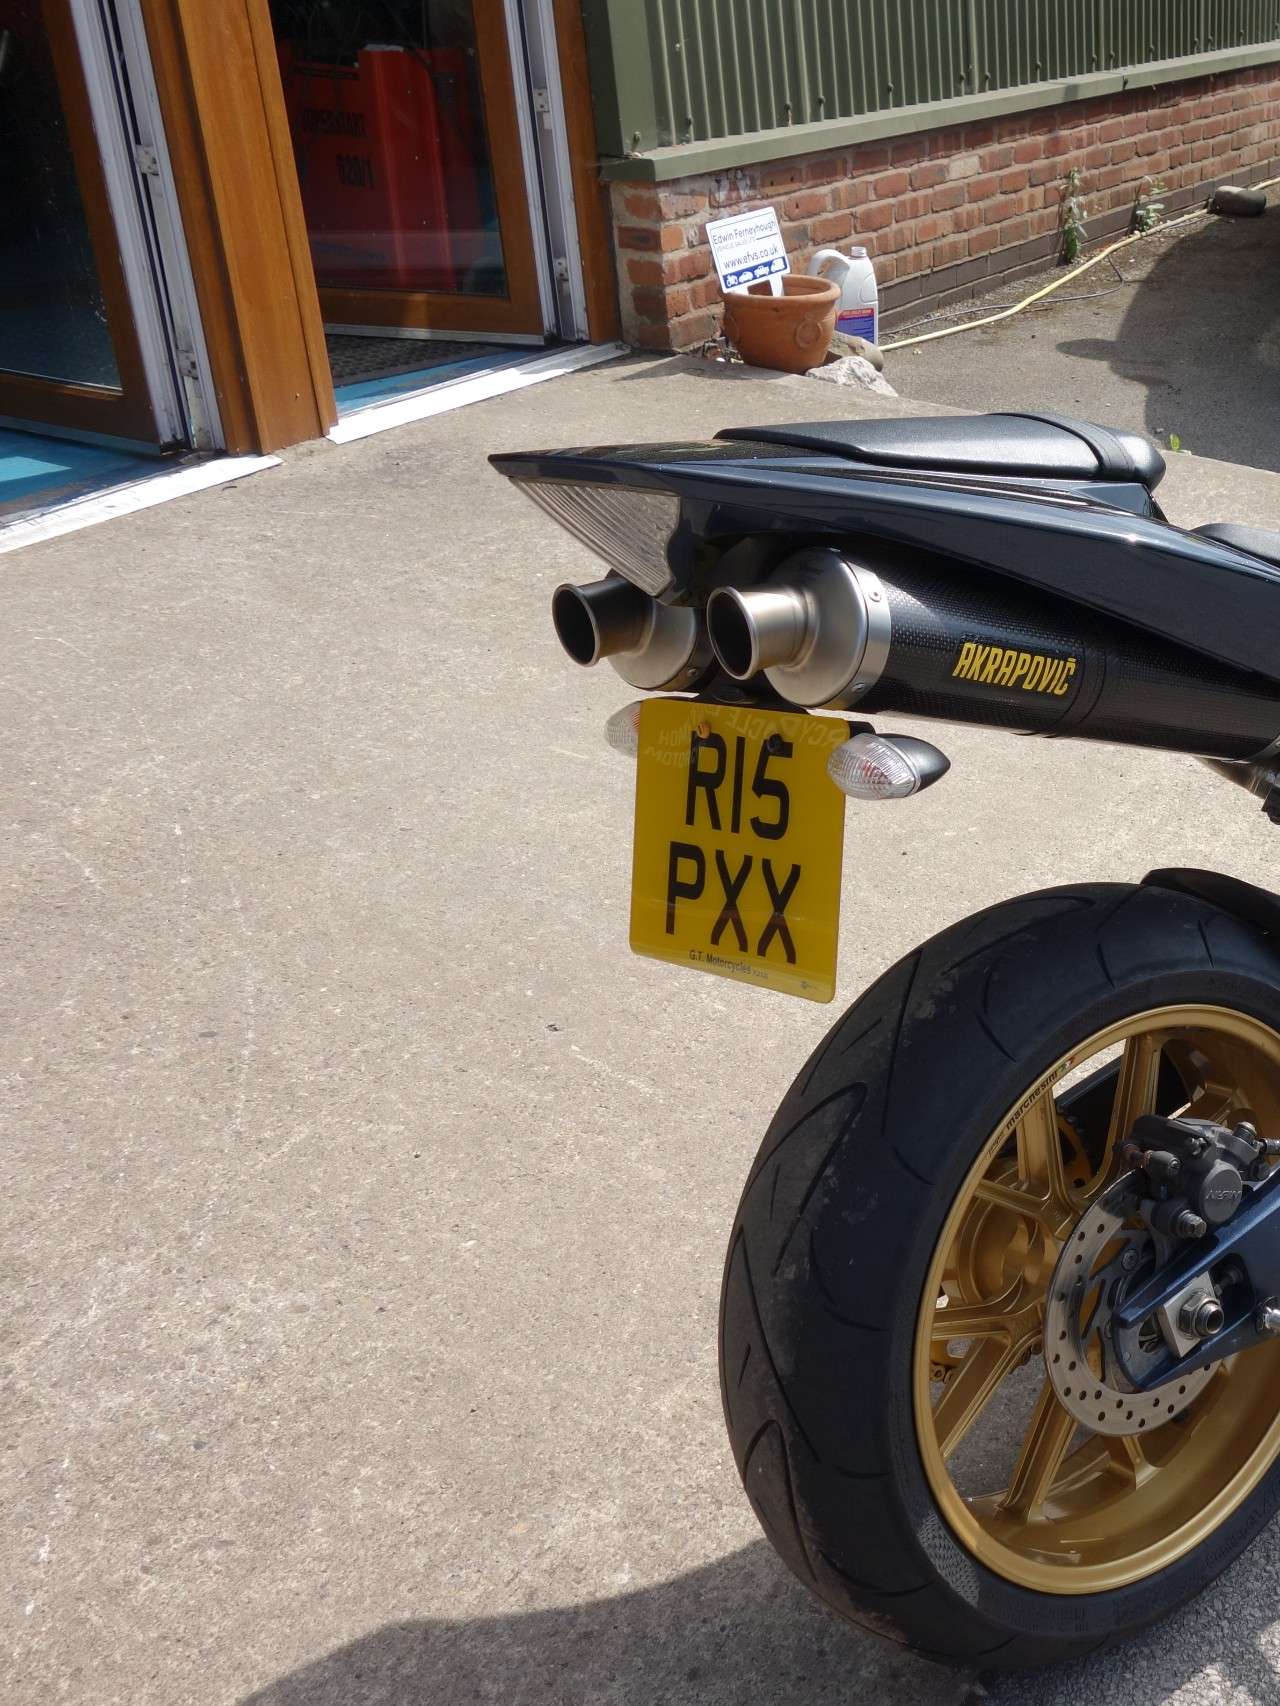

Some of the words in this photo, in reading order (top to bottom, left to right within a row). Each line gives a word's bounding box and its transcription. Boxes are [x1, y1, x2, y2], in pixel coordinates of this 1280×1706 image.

[712, 231, 736, 246] Edwin
[685, 730, 794, 841] R15
[665, 840, 802, 965] PXX
[706, 953, 752, 975] Motorcycles
[1005, 1070, 1059, 1131] marchesini
